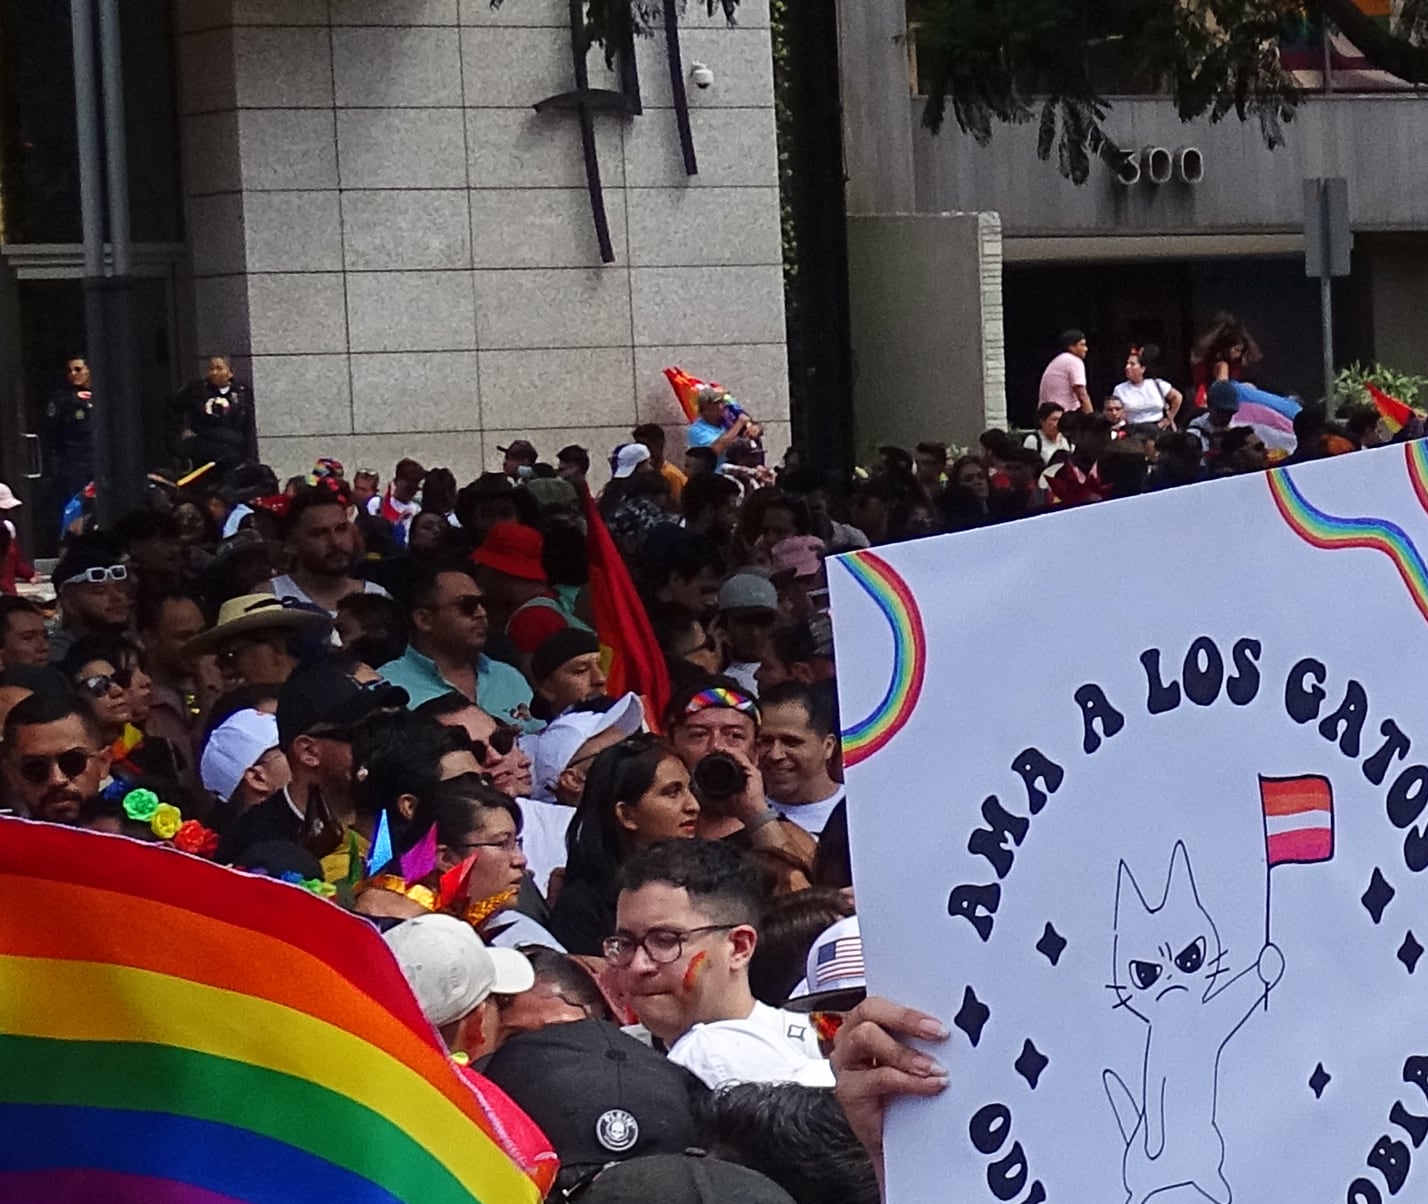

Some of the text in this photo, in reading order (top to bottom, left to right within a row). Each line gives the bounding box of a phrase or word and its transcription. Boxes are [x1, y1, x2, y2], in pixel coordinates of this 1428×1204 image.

[1117, 147, 1204, 185] 300
[948, 748, 1064, 942] AMA
[1074, 684, 1124, 754] A
[1140, 637, 1262, 714] LOS
